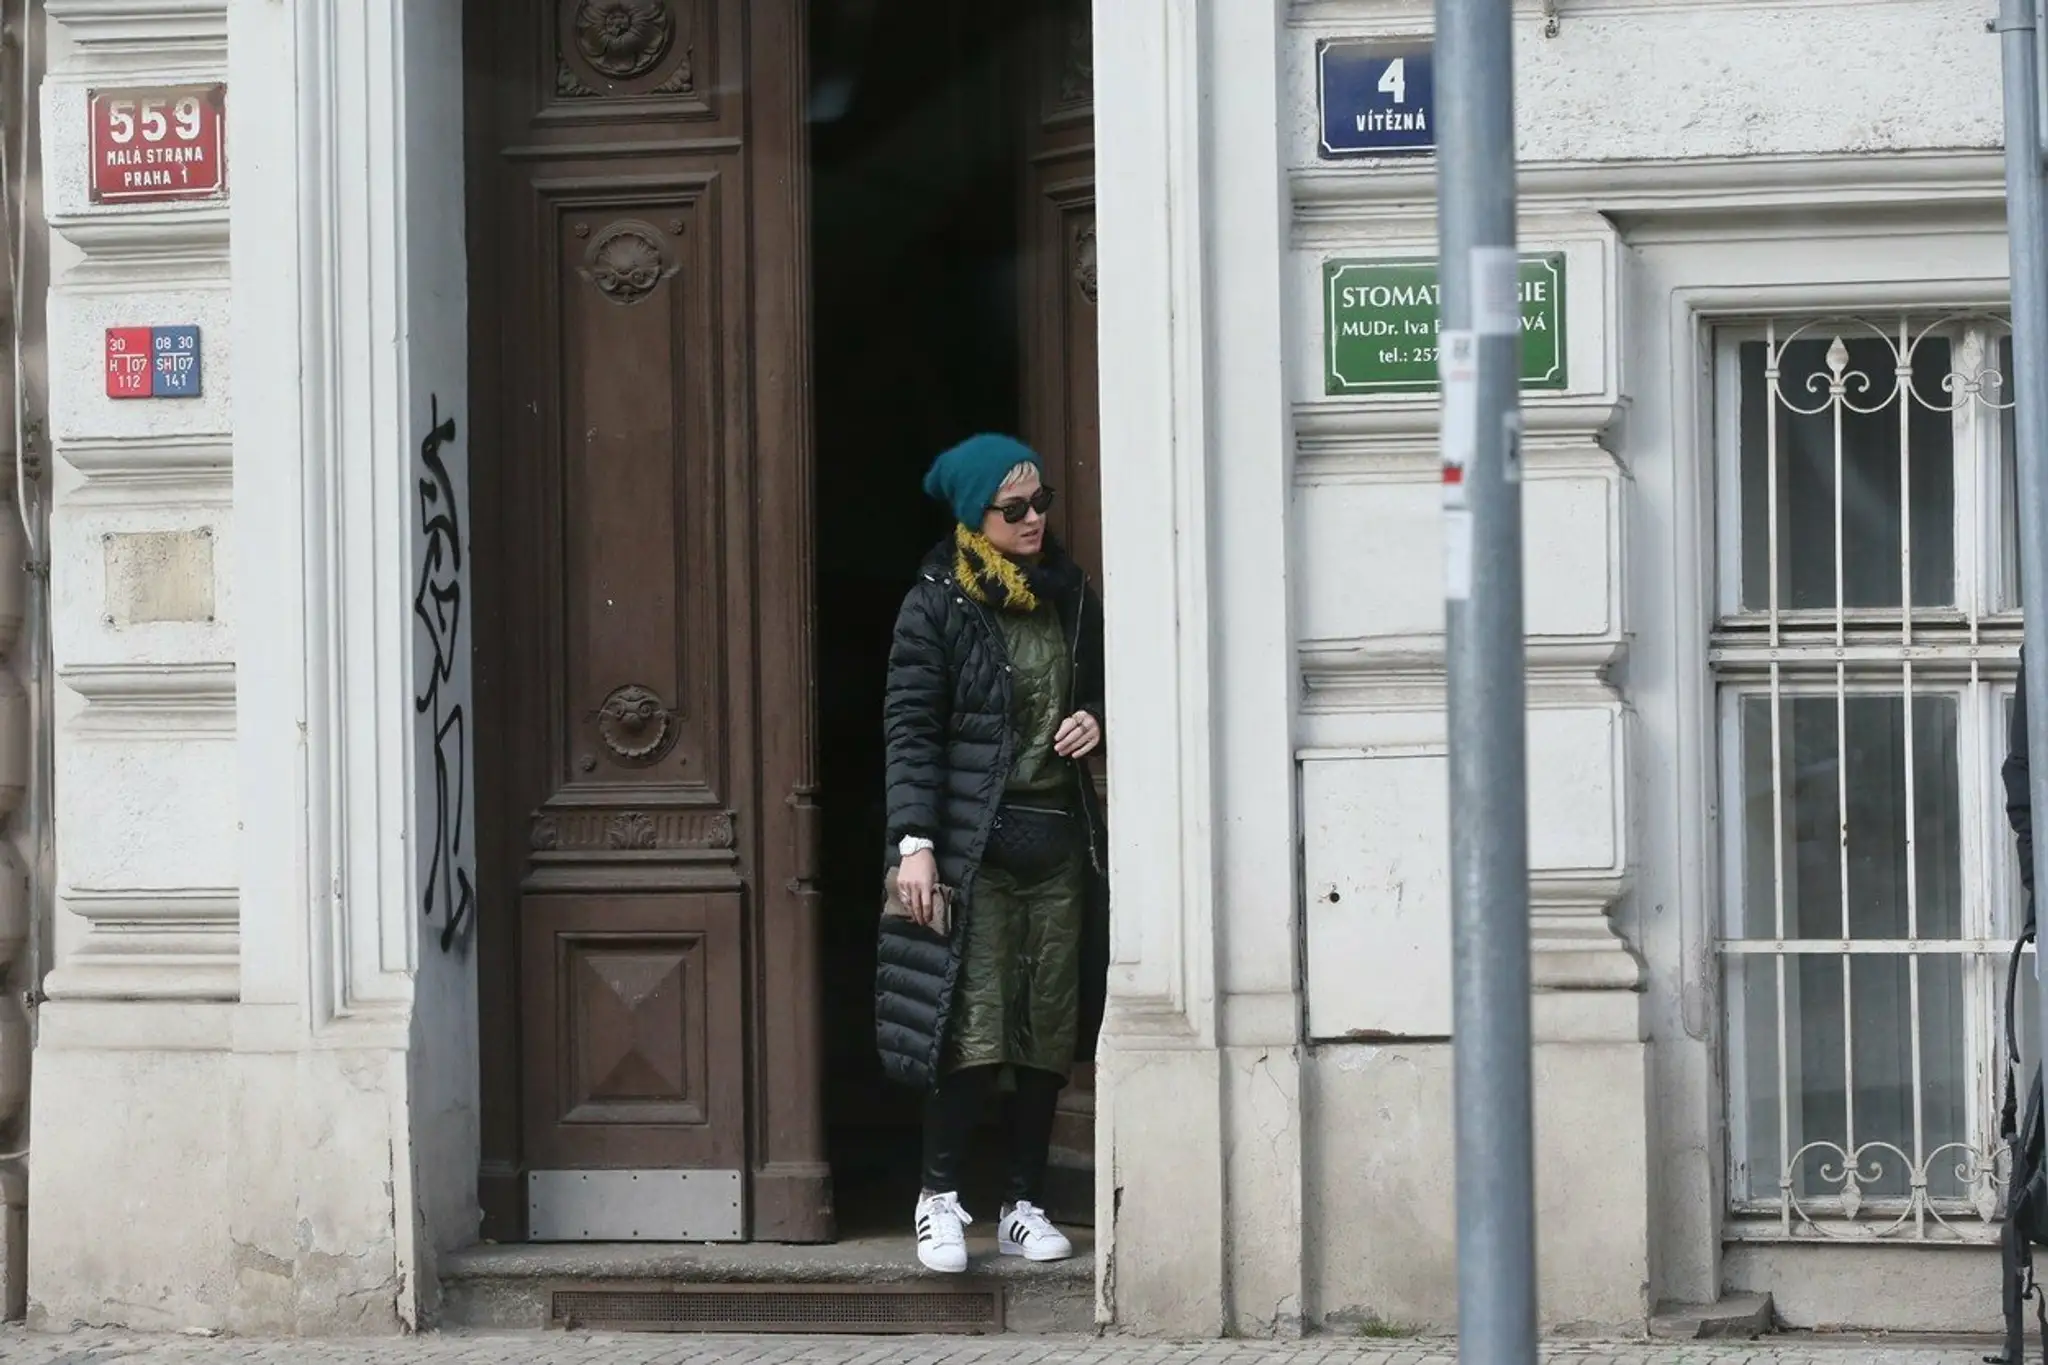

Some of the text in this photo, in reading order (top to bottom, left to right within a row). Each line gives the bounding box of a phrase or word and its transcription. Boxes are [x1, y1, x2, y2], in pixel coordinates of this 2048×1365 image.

[1378, 58, 1405, 103] 4
[110, 97, 200, 143] 559
[1356, 108, 1426, 132] VÍTĚZNÁ
[107, 145, 203, 165] MALÁ STRANA
[124, 167, 188, 187] PRAHA 1
[1342, 281, 1546, 308] STOMATIE
[1342, 321, 1398, 336] MUDr.
[1404, 319, 1428, 334] Iva
[109, 338, 126, 351] 30
[155, 336, 193, 350] 08 30
[1379, 349, 1407, 363] tel.:
[110, 358, 147, 371] H 07
[156, 357, 194, 371] SH 07
[118, 375, 141, 388] 112
[165, 374, 186, 387] 141
